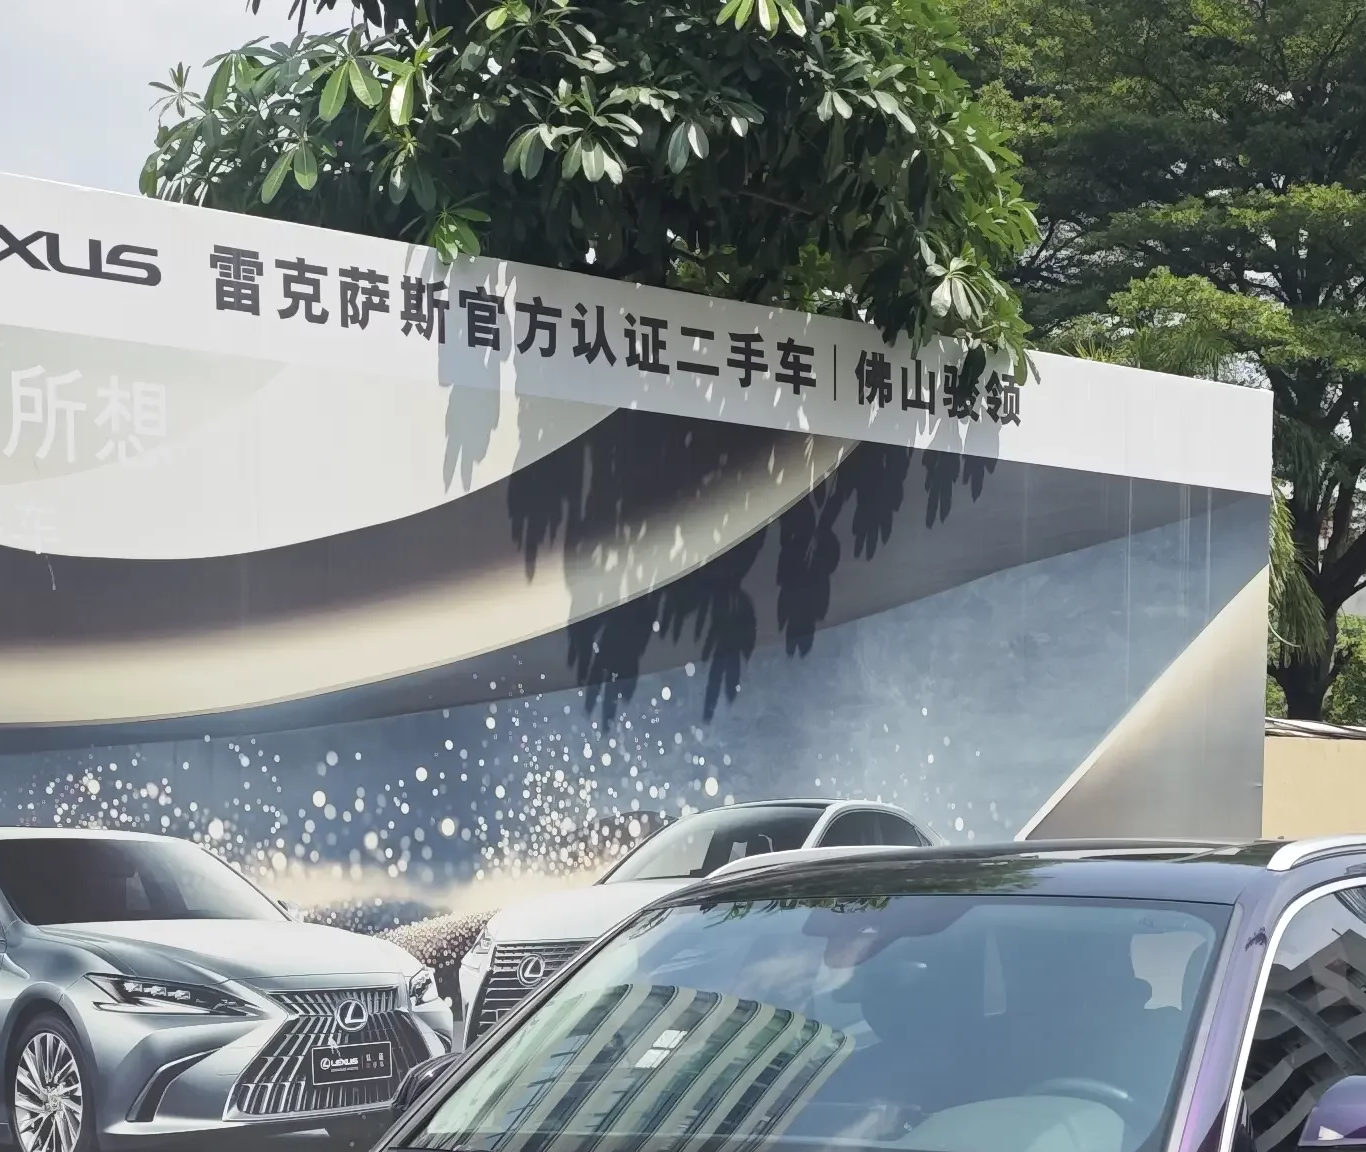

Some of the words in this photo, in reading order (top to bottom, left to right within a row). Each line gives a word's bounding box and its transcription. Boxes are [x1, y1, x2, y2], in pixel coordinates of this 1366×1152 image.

[208, 242, 818, 397] 雷克萨斯官方认证二手车
